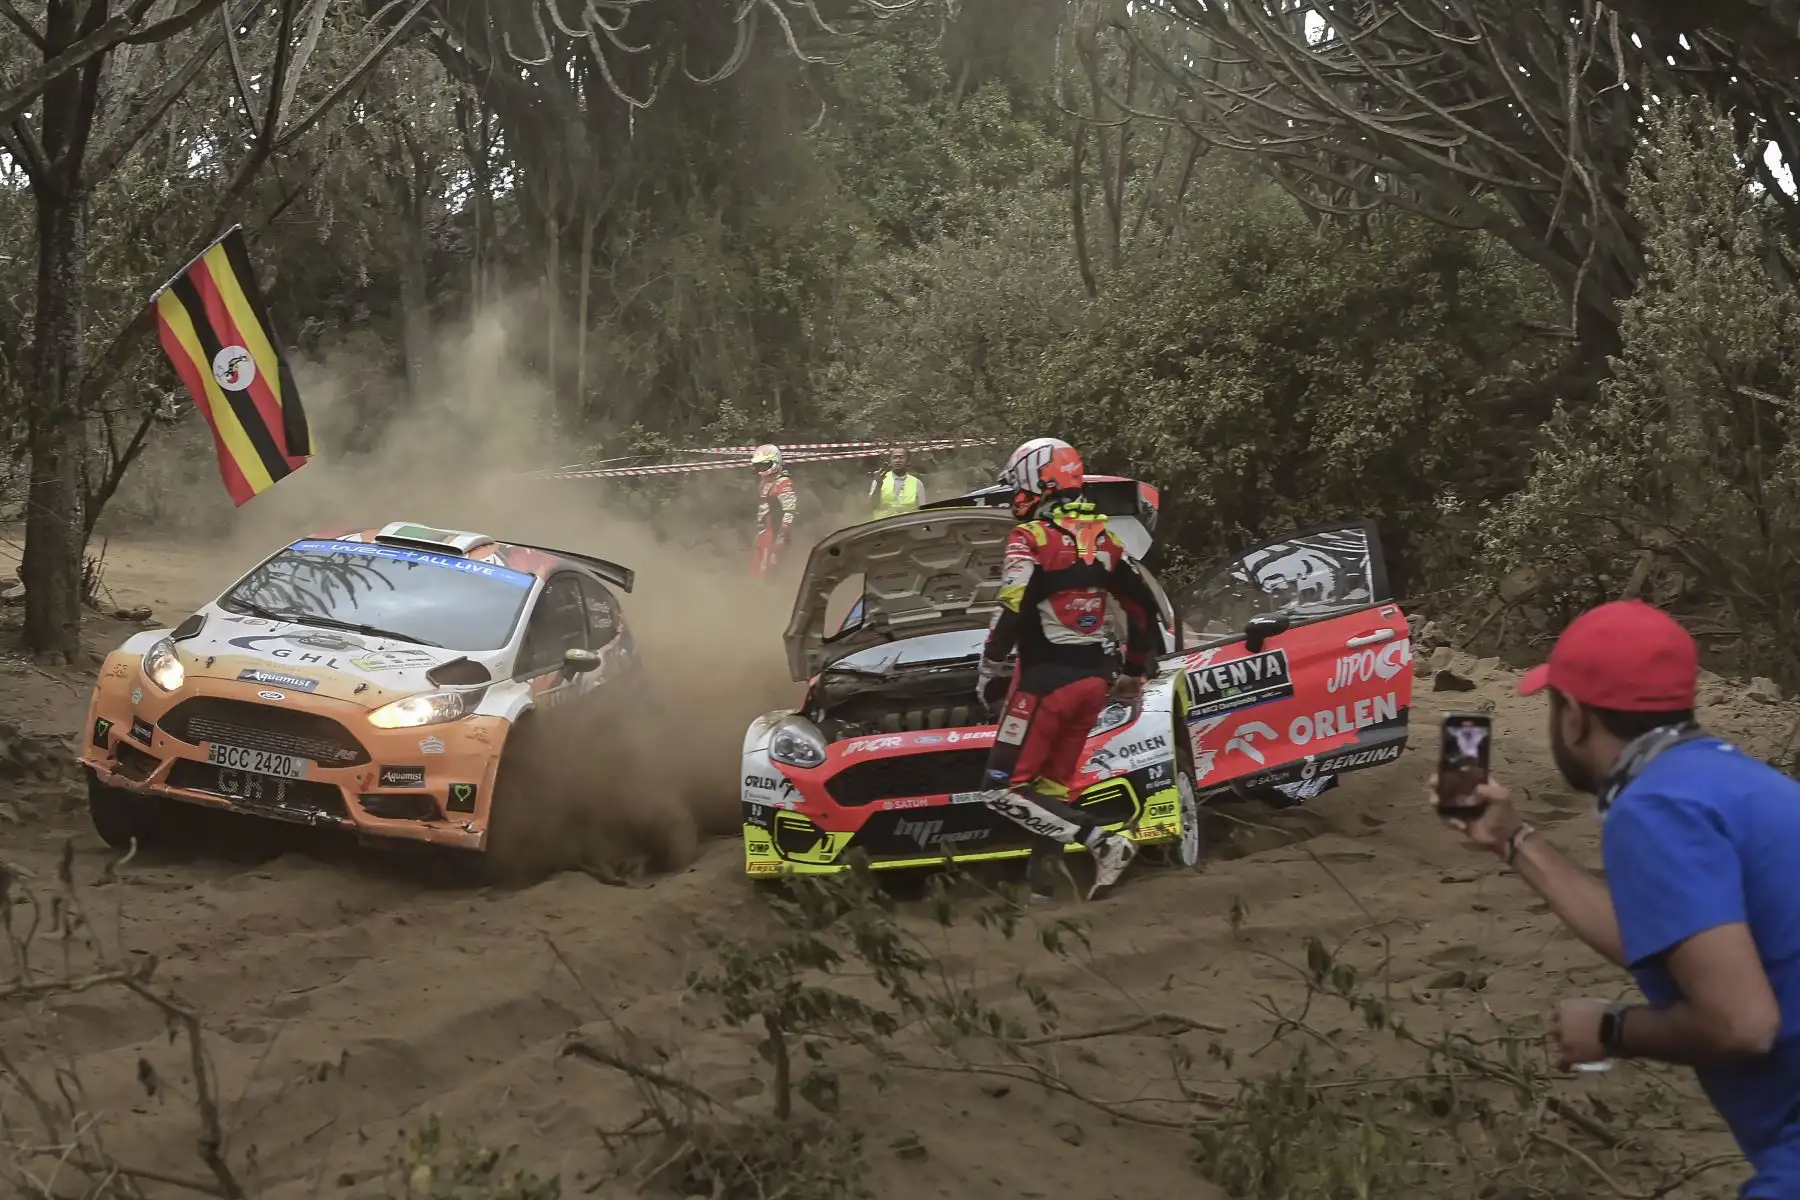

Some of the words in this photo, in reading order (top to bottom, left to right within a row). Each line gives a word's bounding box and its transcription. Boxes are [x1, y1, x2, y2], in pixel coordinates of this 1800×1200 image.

[416, 554, 450, 566] ALL
[454, 560, 494, 575] LIVE
[245, 671, 314, 688] Aquamist
[1193, 654, 1282, 695] KENYA
[1288, 691, 1398, 745] ORLEN
[1119, 735, 1167, 759] ORLEN
[216, 745, 250, 768] BCC
[254, 752, 292, 776] 2420
[1319, 745, 1400, 773] BENZINA
[382, 771, 422, 783] Aquamist
[744, 775, 777, 791] ORLEN
[1257, 772, 1290, 787] SATUM
[894, 799, 928, 809] SATUM
[1149, 804, 1175, 816] OMP
[750, 843, 770, 853] OMP
